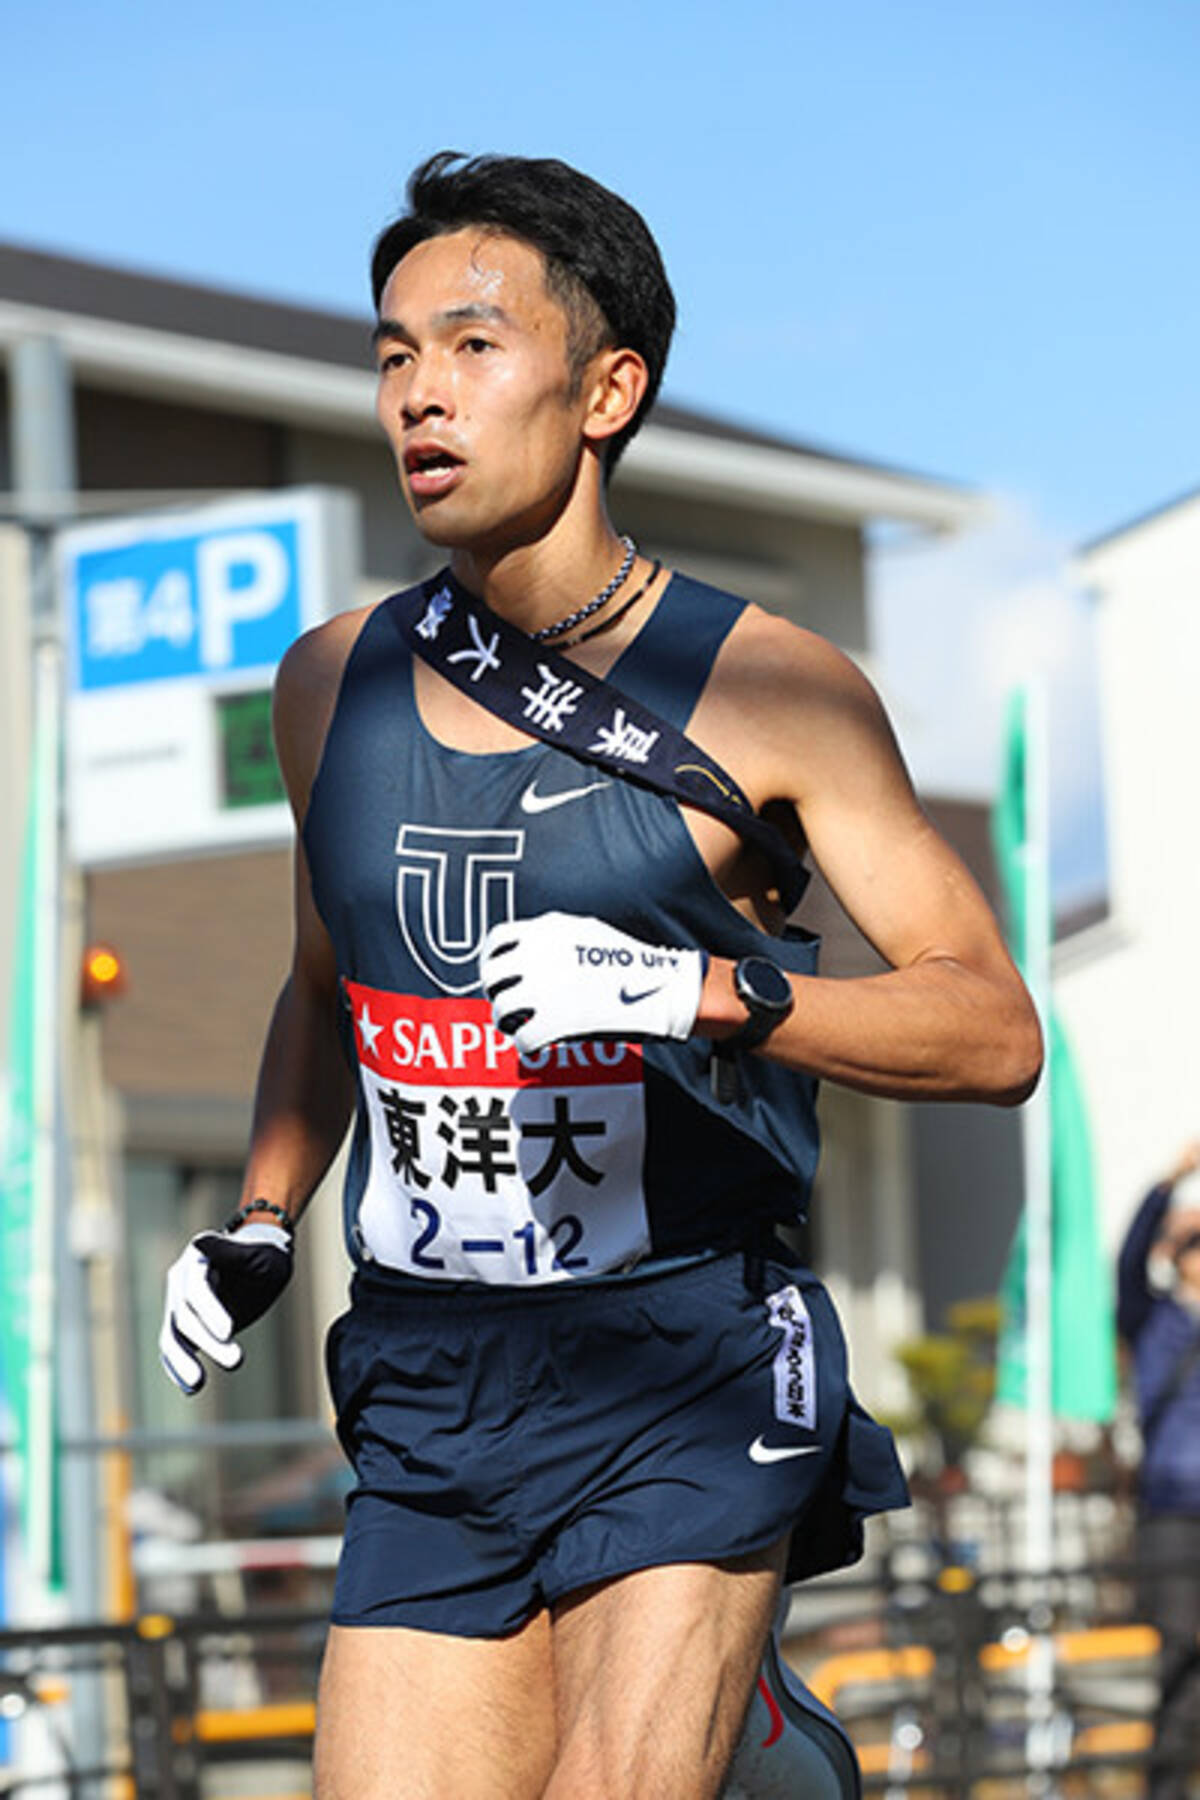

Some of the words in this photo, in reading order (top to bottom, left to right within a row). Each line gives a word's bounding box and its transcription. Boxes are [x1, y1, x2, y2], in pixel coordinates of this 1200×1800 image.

[199, 531, 290, 669] P
[576, 945, 634, 967] TOYO
[378, 1088, 606, 1198] 東洋大
[411, 1198, 589, 1275] 2-12
